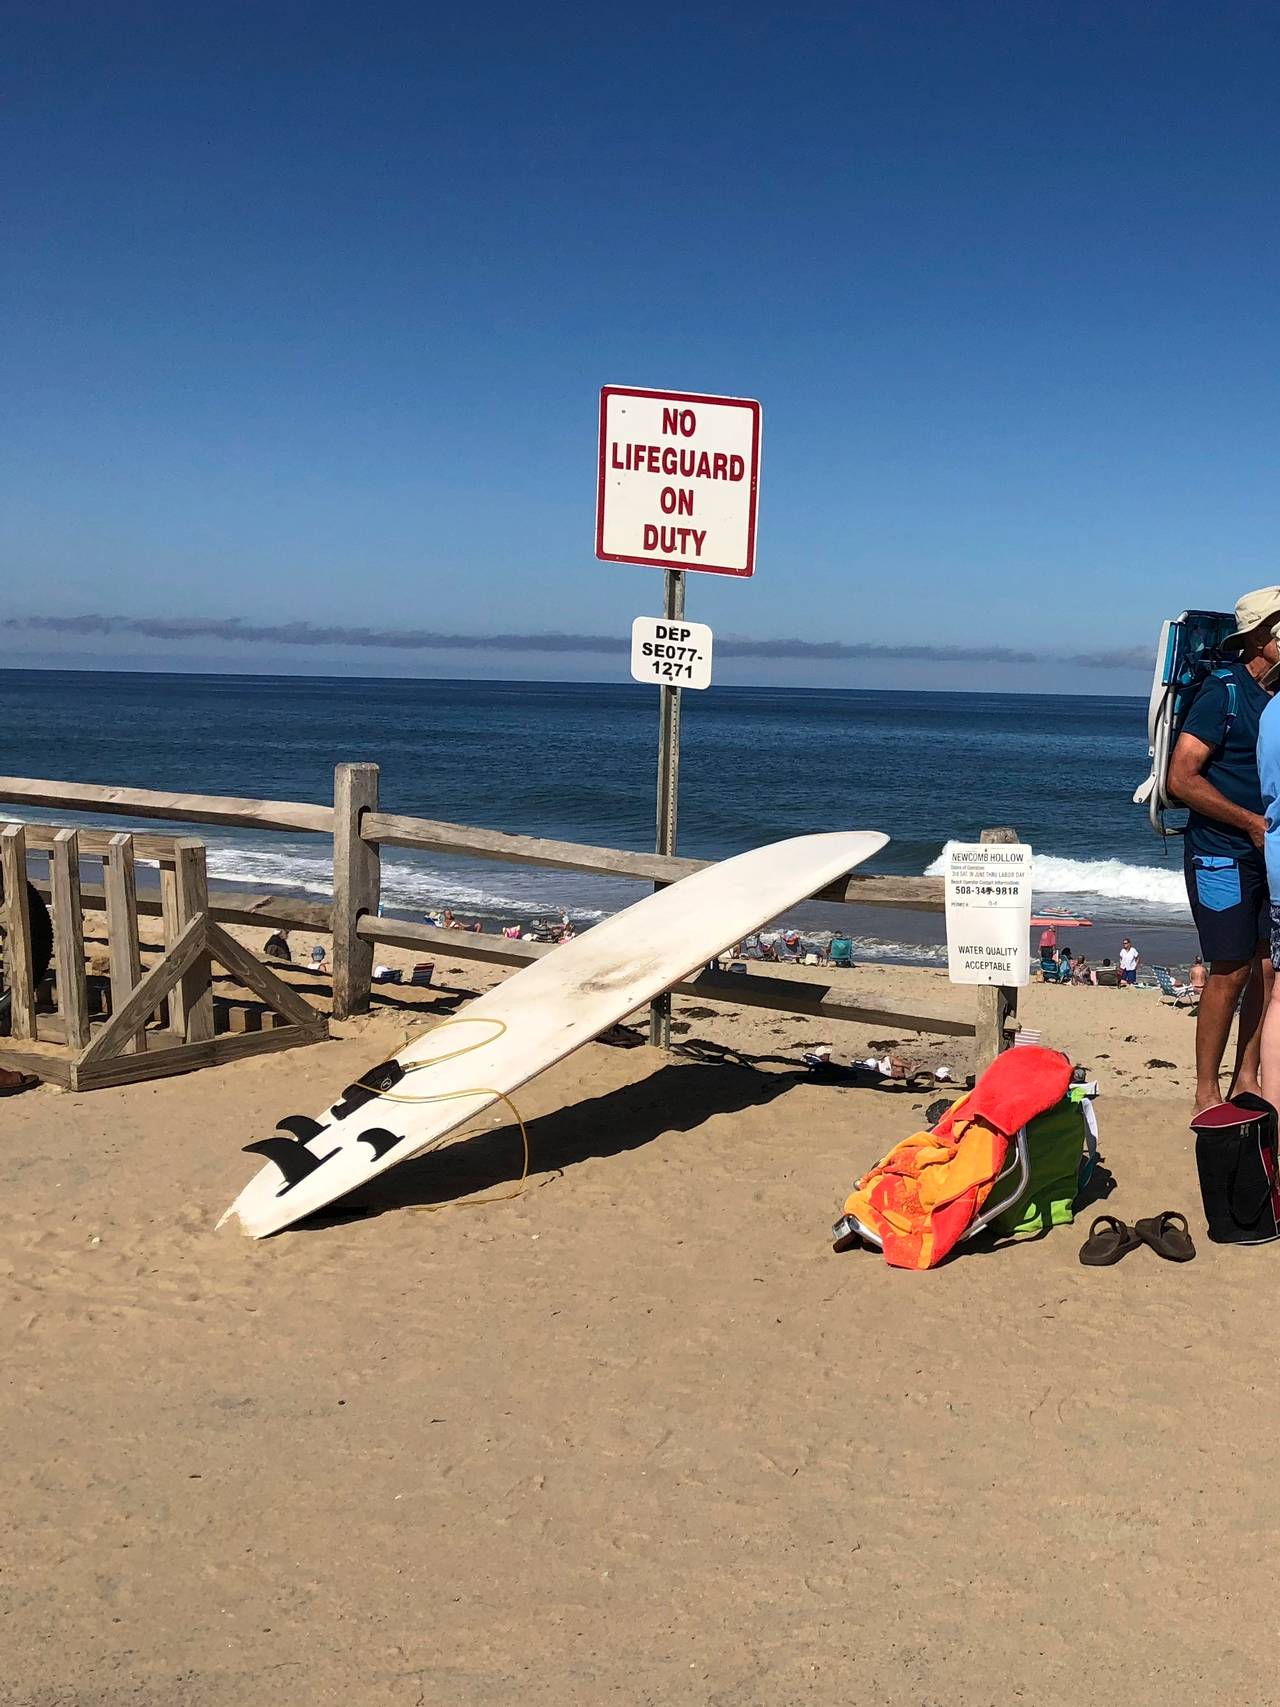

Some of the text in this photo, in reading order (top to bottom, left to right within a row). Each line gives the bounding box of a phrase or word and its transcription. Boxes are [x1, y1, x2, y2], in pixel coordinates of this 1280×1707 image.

[662, 407, 697, 437] NO
[611, 442, 745, 482] LIFEGUARD
[660, 486, 694, 516] ON
[643, 523, 707, 557] DUTY
[655, 625, 691, 642] DEP
[642, 642, 703, 662] SE077-
[652, 660, 692, 679] 1271
[951, 852, 1024, 862] NEWCOMB HOLLOW
[958, 945, 1018, 956] WATER QUALITY
[965, 961, 1012, 971] ACCEPTABLE
